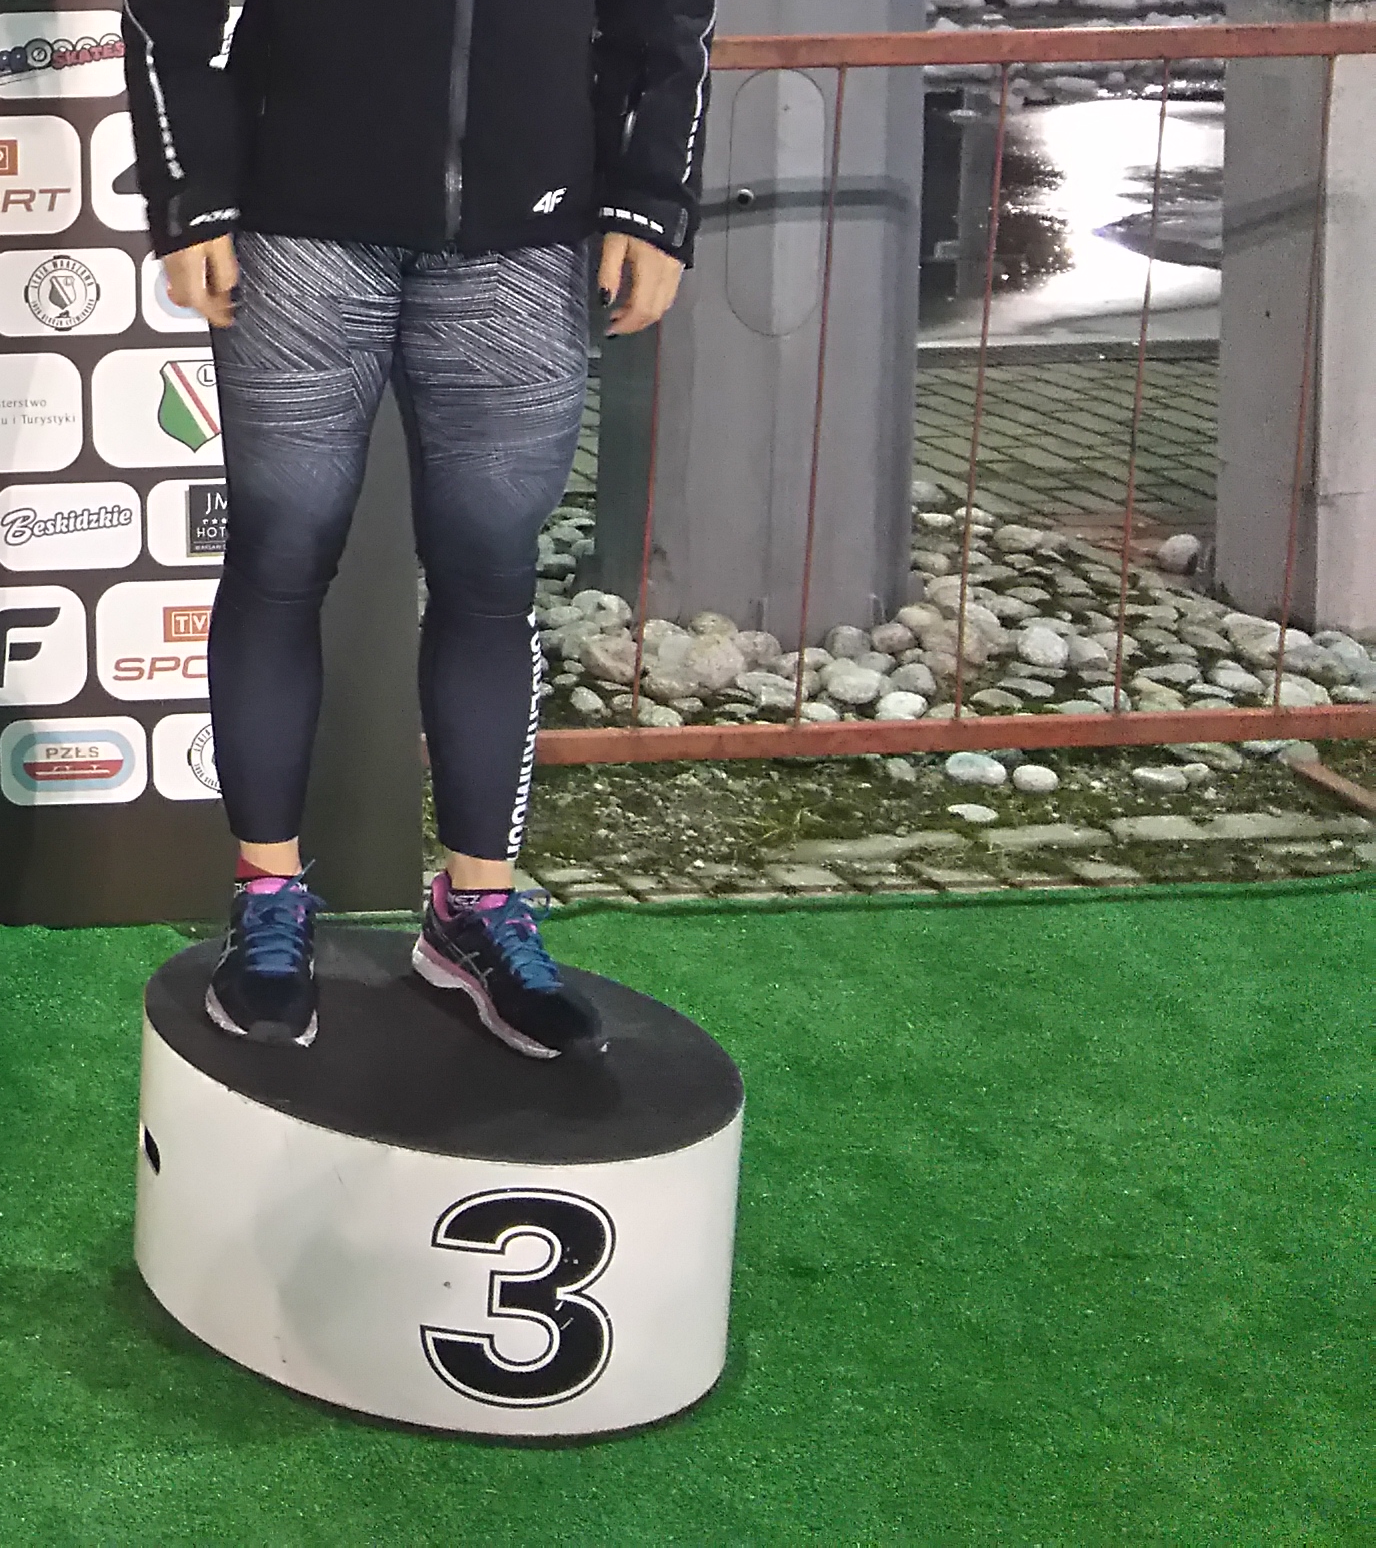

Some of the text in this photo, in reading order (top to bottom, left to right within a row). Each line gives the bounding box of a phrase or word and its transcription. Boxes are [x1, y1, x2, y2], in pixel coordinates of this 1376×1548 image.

[533, 188, 567, 214] 4F
[20, 412, 77, 427] Turystyki
[0, 504, 134, 546] Beskidzkie
[45, 745, 100, 760] PZŁS
[419, 1187, 616, 1410] 3
